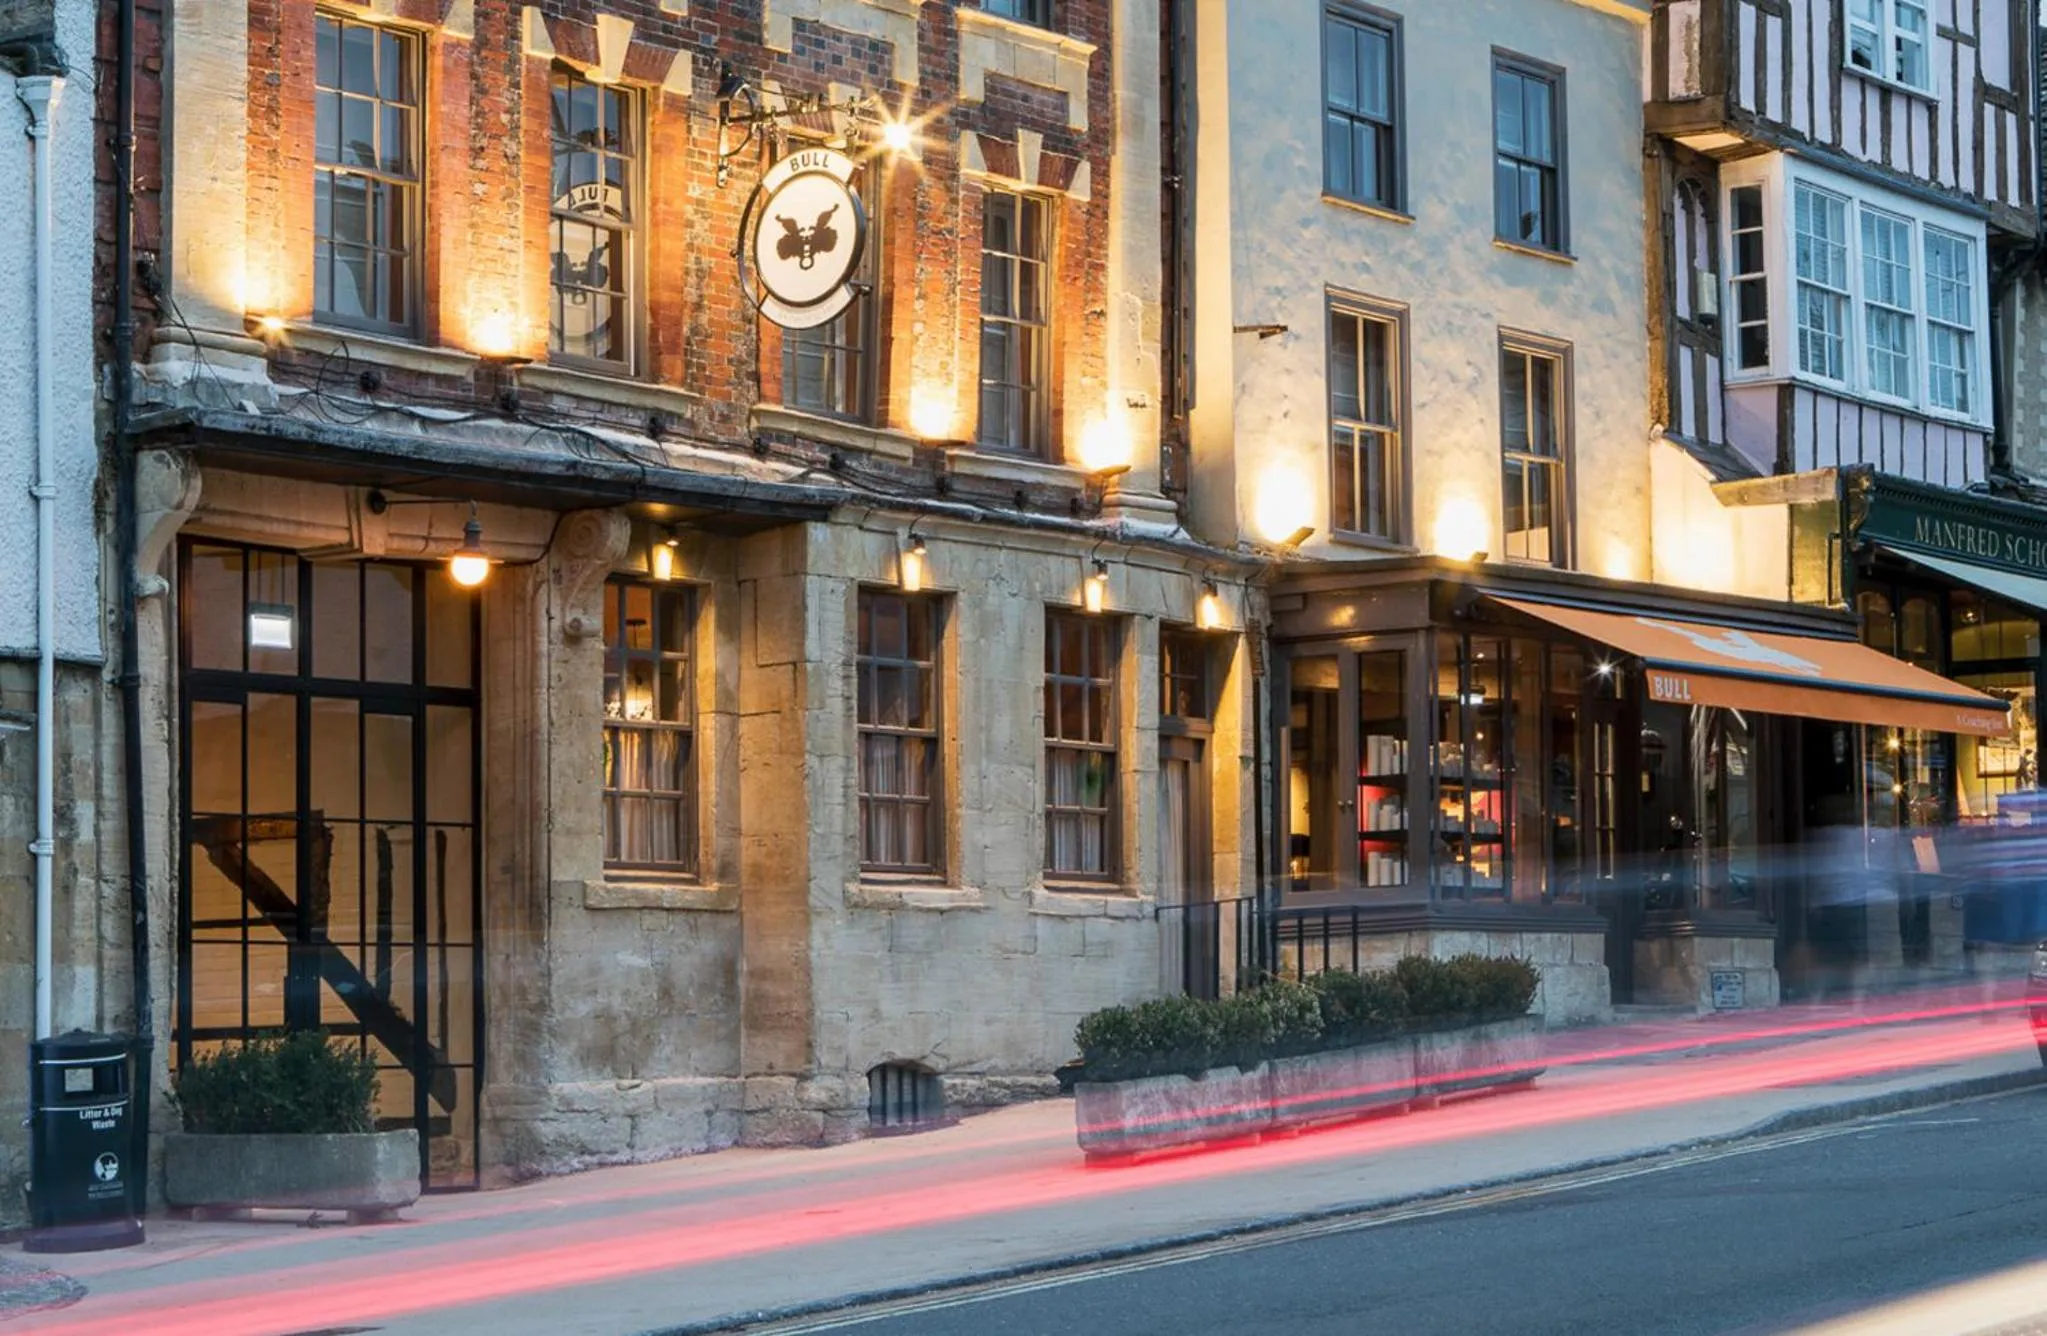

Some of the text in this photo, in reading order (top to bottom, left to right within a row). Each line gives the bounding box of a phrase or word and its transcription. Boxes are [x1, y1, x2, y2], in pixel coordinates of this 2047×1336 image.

[790, 152, 829, 171] BULL
[1916, 516, 2000, 557] MANFRED
[1654, 676, 1691, 700] BULL
[80, 1110, 102, 1120] Litter
[103, 1107, 110, 1117] &
[92, 1119, 116, 1130] Waste
